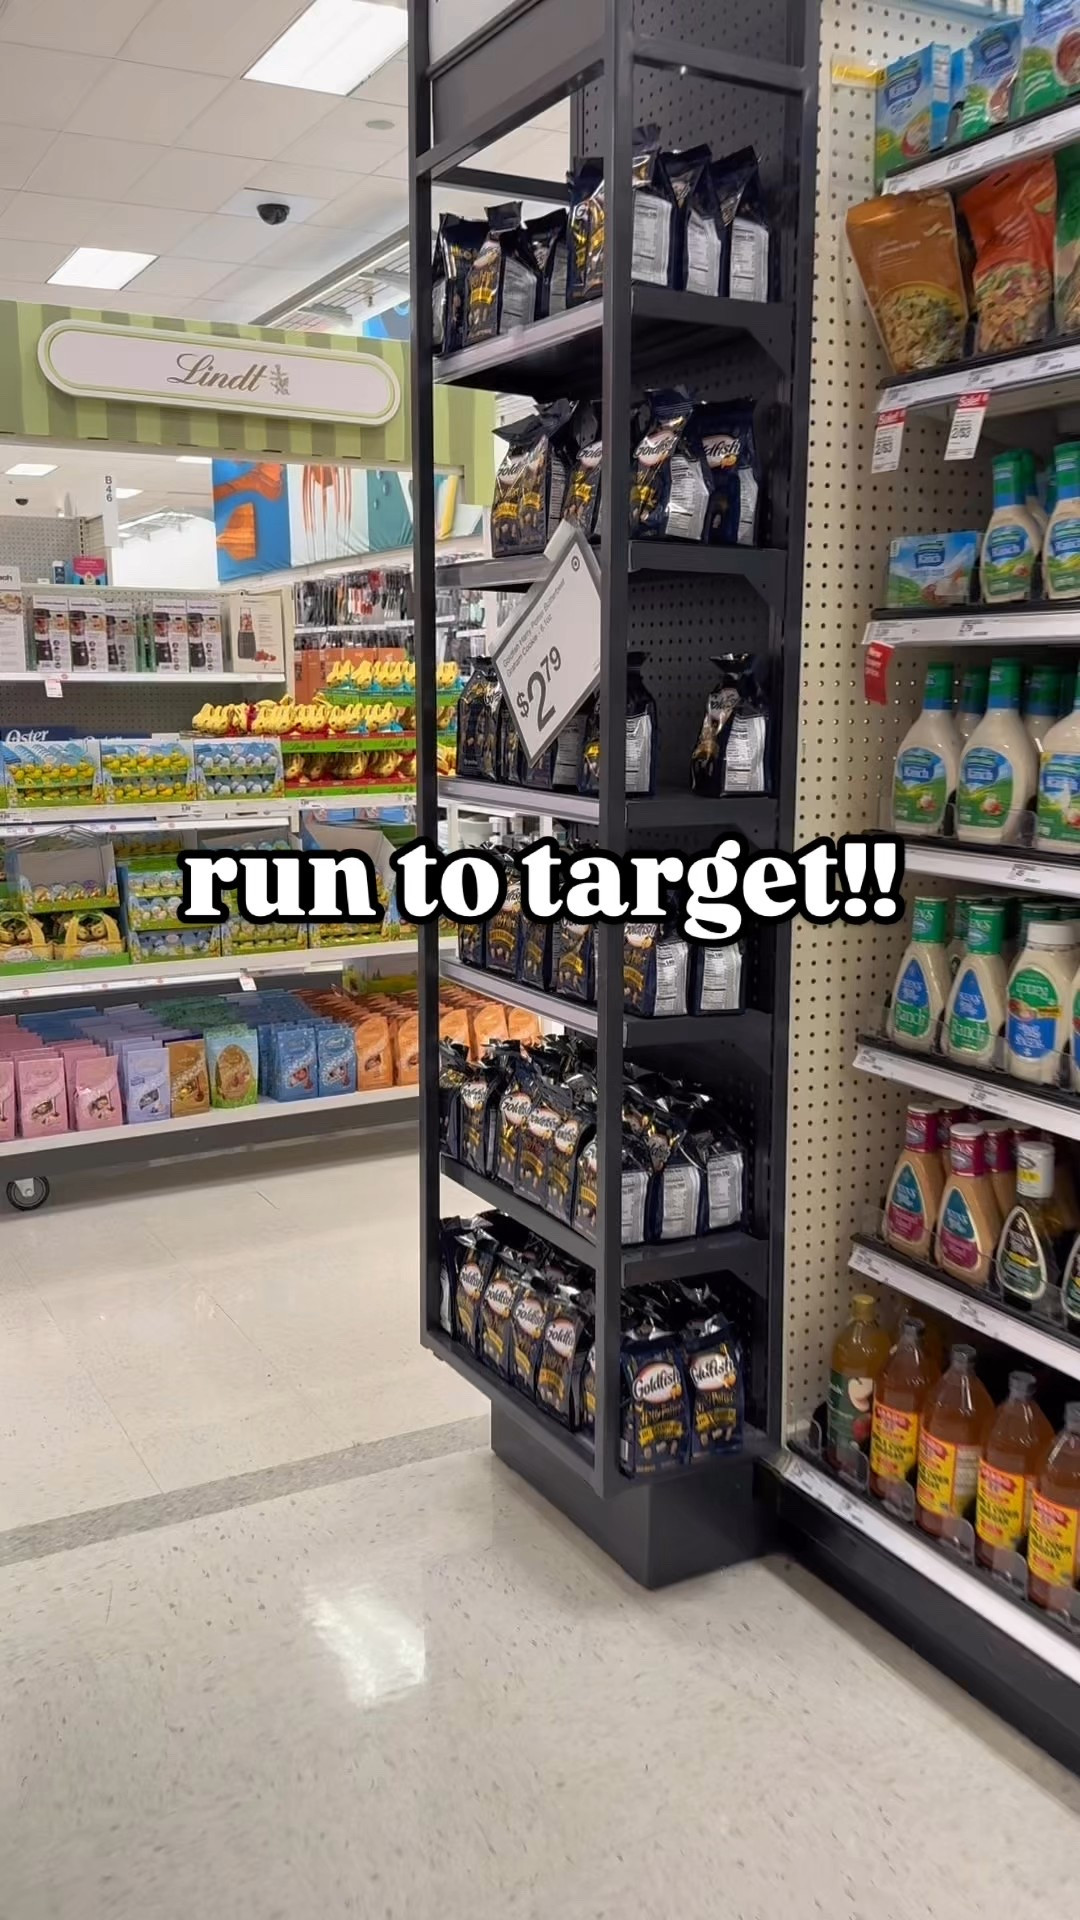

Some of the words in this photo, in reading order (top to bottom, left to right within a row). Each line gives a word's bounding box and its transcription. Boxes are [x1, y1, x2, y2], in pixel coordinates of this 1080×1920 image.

[166, 353, 268, 392] Lindt
[5, 729, 50, 743] Oster
[633, 1363, 681, 1400] Goldfish
